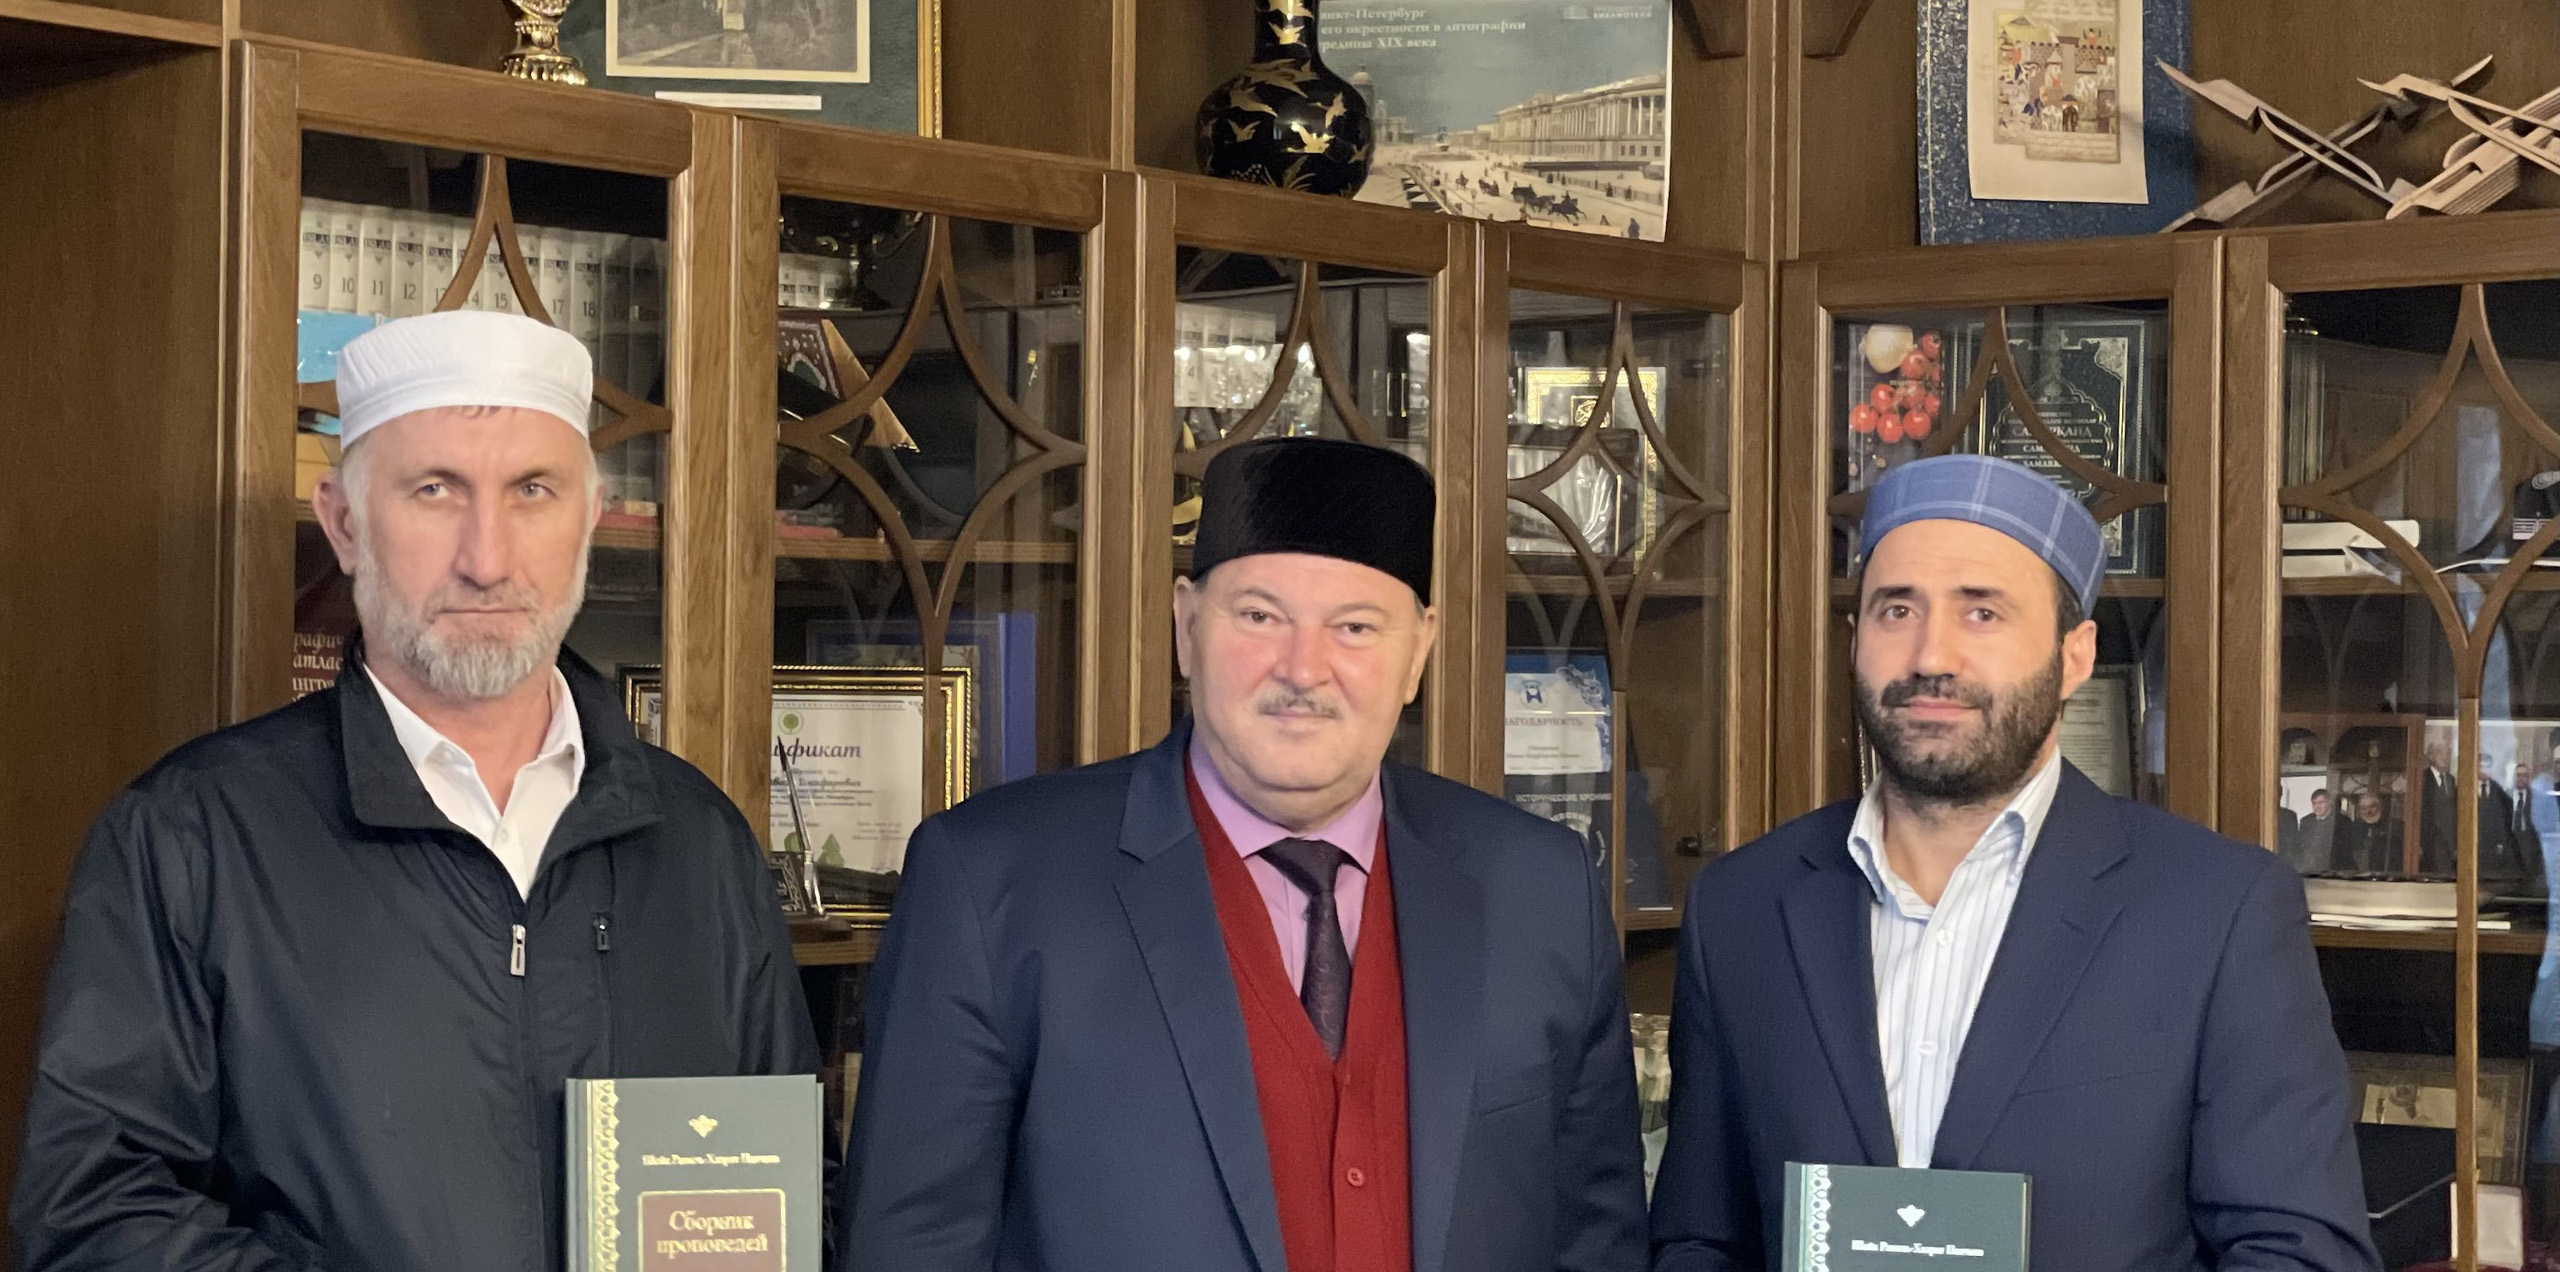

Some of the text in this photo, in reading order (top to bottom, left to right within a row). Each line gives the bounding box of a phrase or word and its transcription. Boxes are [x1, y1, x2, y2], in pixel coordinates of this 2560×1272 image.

[1321, 20, 1526, 37] его окрестности в литографии
[1377, 37, 1402, 48] XIX
[1406, 39, 1436, 48] века
[312, 273, 323, 291] 9
[341, 277, 355, 295] 10
[371, 280, 385, 297] 11
[403, 283, 418, 300] 12
[495, 292, 508, 310] 15
[552, 299, 565, 315] 17
[582, 301, 596, 318] 18
[668, 1209, 755, 1237] Сборник
[656, 1232, 769, 1260] проповедей
